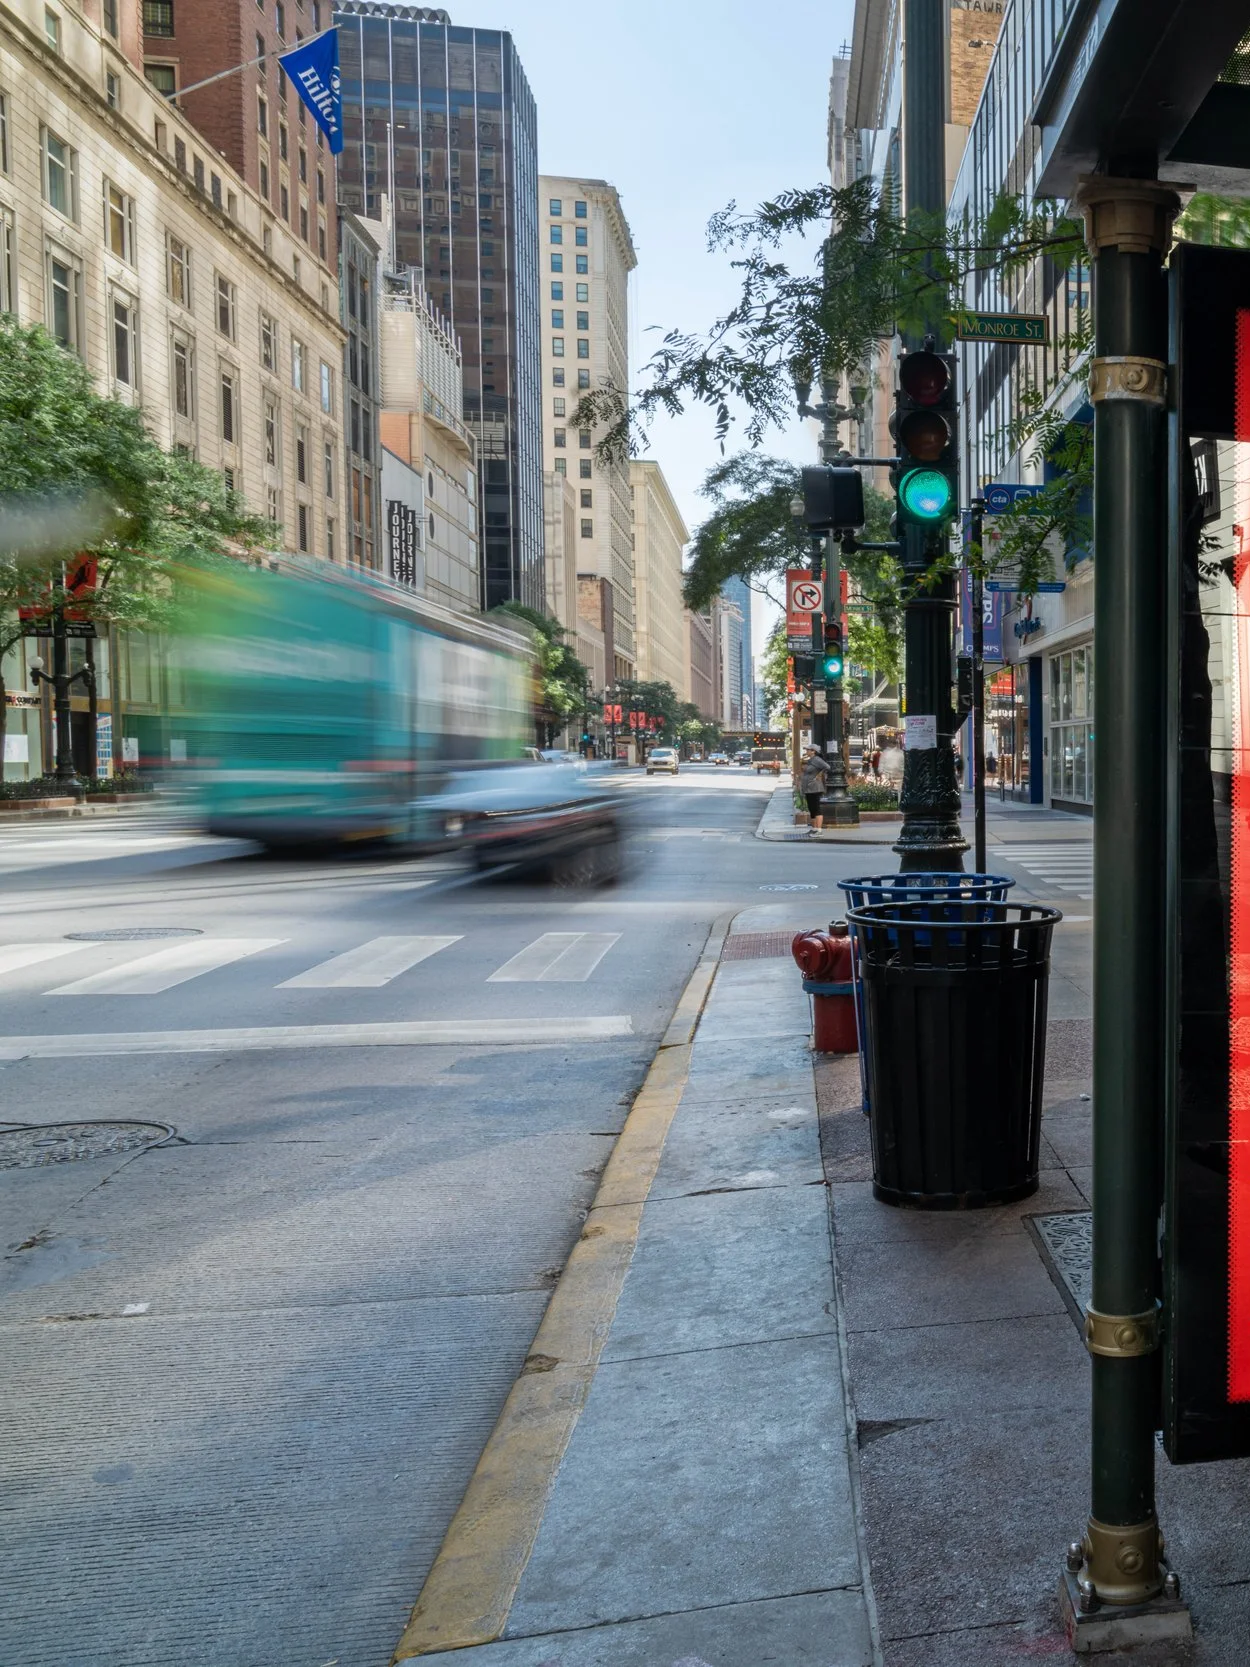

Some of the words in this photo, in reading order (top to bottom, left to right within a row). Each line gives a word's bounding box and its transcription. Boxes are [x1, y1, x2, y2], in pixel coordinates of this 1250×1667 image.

[297, 65, 338, 134] Hilto
[965, 319, 1020, 336] MONROE
[1025, 321, 1042, 338] ST.
[991, 496, 1007, 504] cta
[391, 502, 401, 584] JOURNEY
[966, 644, 999, 653] CMPS
